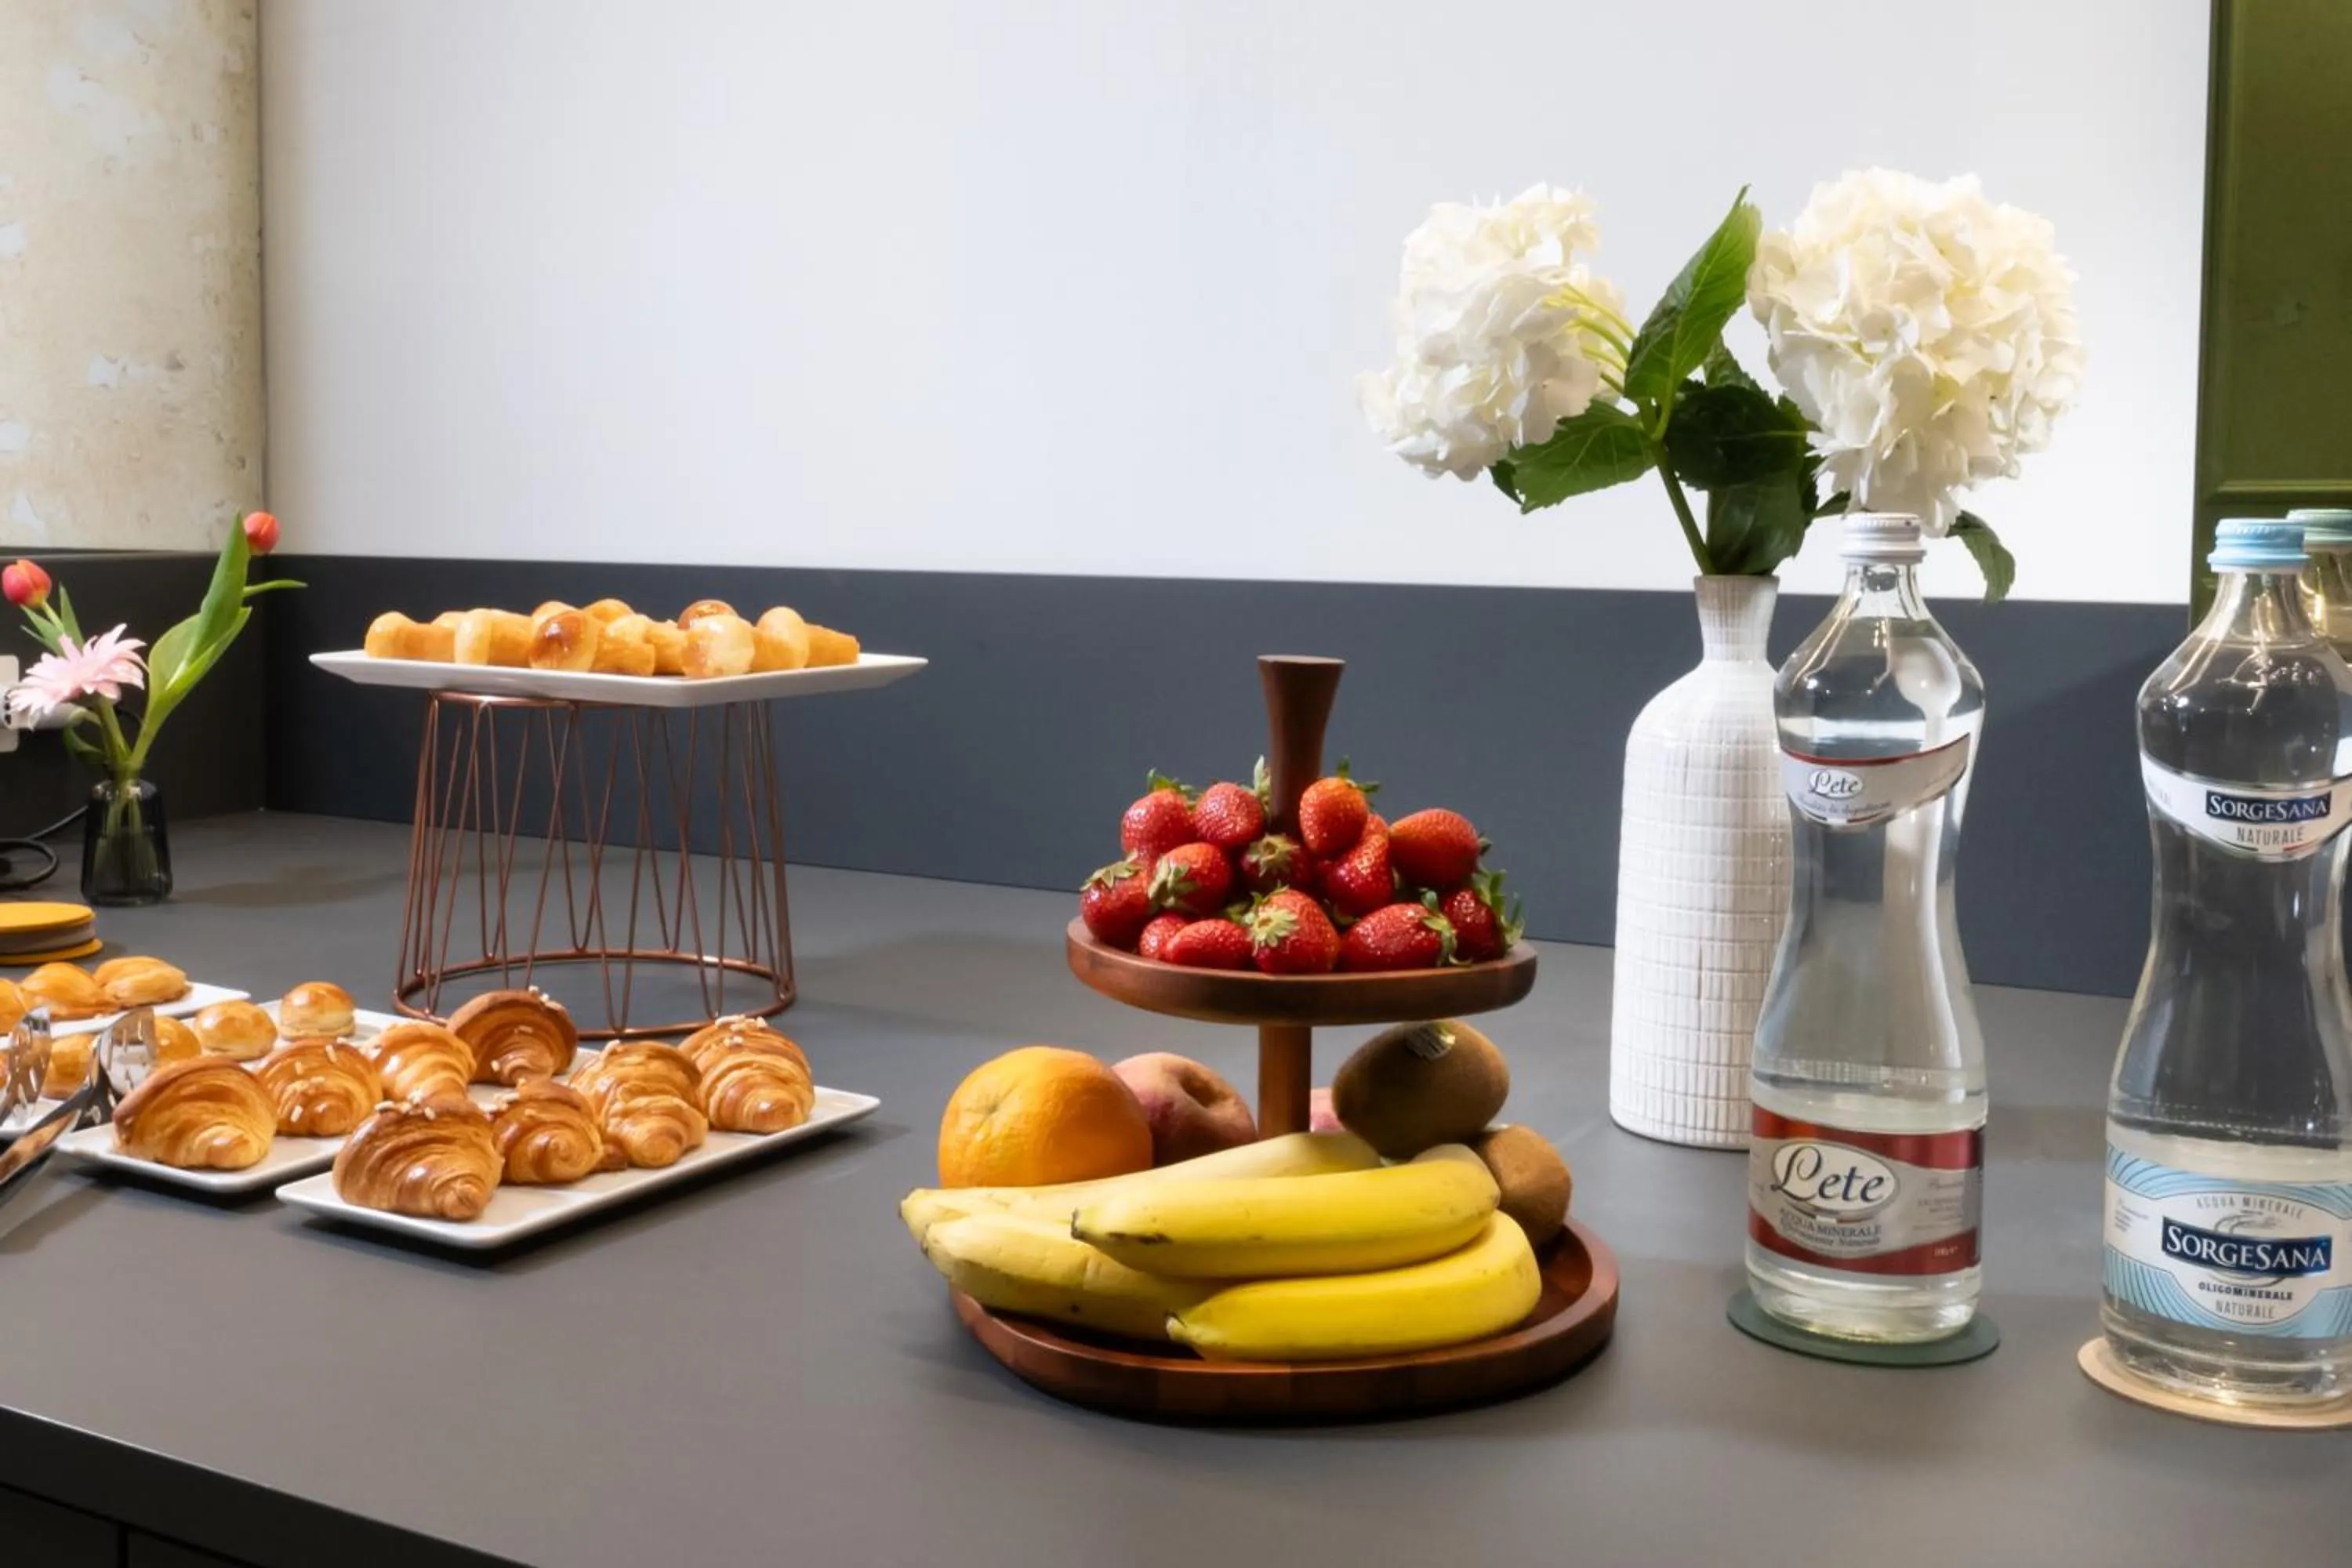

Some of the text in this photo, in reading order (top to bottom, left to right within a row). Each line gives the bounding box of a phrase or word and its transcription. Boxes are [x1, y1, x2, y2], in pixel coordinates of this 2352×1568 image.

[1809, 770, 1858, 797] Lete
[2209, 795, 2327, 821] SORGESANA
[2236, 826, 2304, 845] NATURALE
[1770, 1145, 1885, 1203] Lete
[2196, 1196, 2303, 1220] ACQUA MINERALE
[1817, 1224, 1882, 1238] MINERALE
[2166, 1225, 2327, 1271] SORGESANA
[2198, 1281, 2292, 1301] OLIGOMINERALE
[2216, 1300, 2275, 1319] NATURALE
